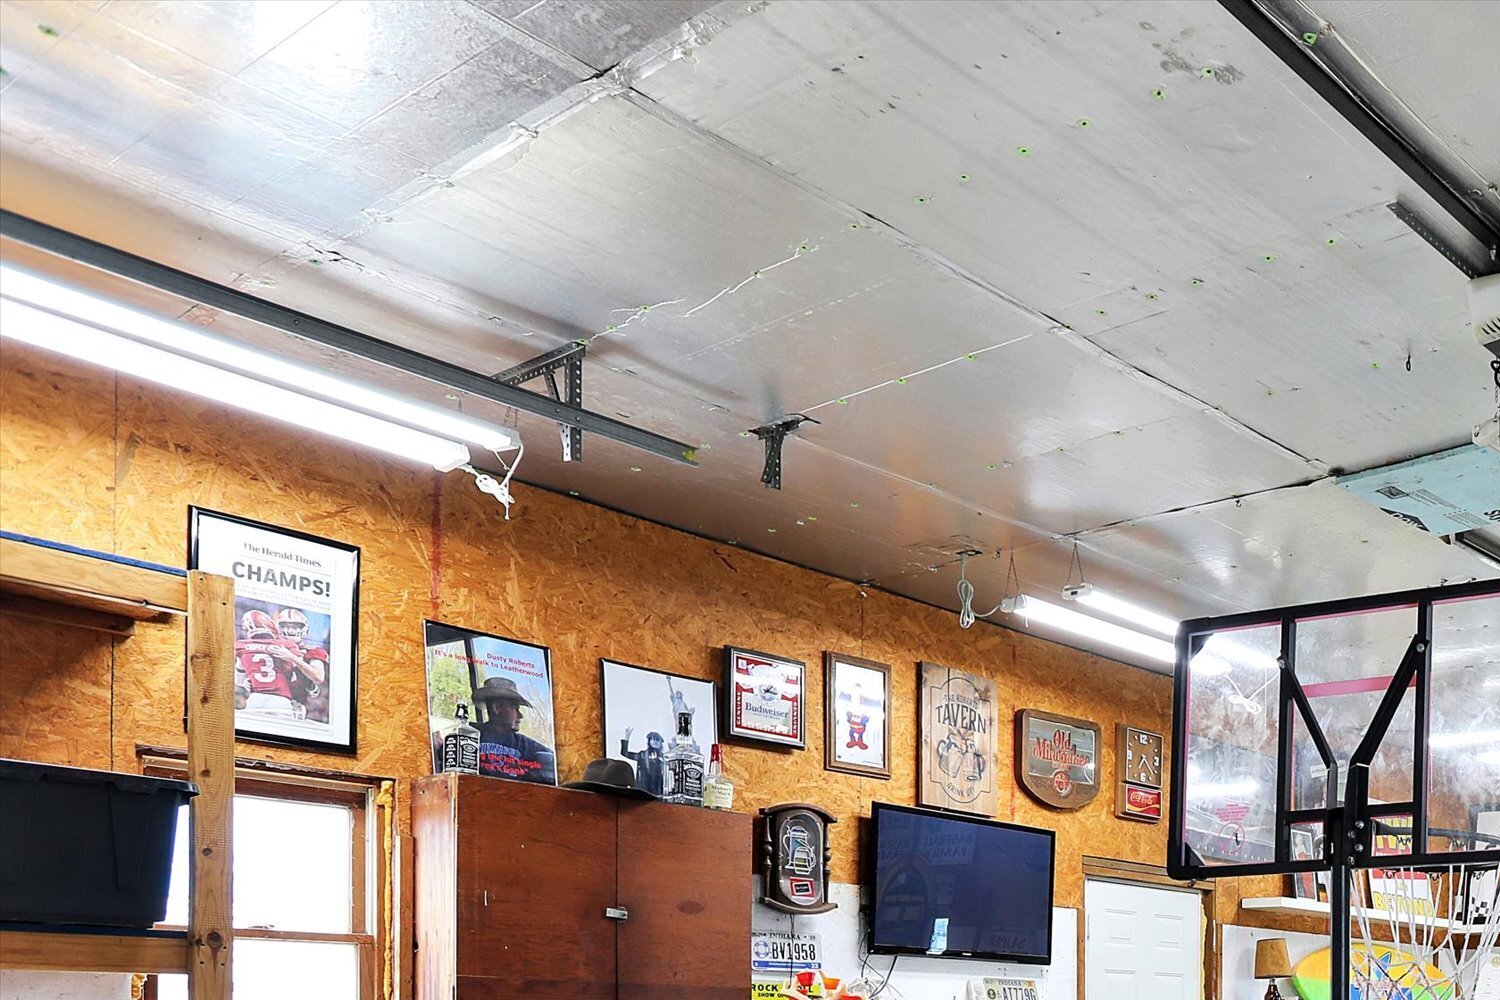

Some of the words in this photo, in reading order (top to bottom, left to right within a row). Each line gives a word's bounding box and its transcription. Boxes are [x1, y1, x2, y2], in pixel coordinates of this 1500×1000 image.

[244, 543, 261, 554] The
[232, 561, 331, 598] CHAMPS!
[251, 653, 277, 683] 3
[434, 649, 447, 657] It's
[491, 661, 499, 669] to
[500, 664, 544, 679] Leatherwood
[486, 653, 507, 663] Dusty
[508, 657, 535, 669] Roberts
[745, 702, 790, 718] Budweiser
[936, 703, 987, 734] TAVERN
[1053, 729, 1072, 752] Old
[1139, 733, 1147, 745] 12
[1154, 756, 1160, 767] 3
[1140, 773, 1146, 782] 6
[769, 932, 800, 941] INDIANA
[772, 942, 816, 961] BV1958
[752, 984, 779, 992] ROCK
[998, 979, 1022, 987] INDIANA
